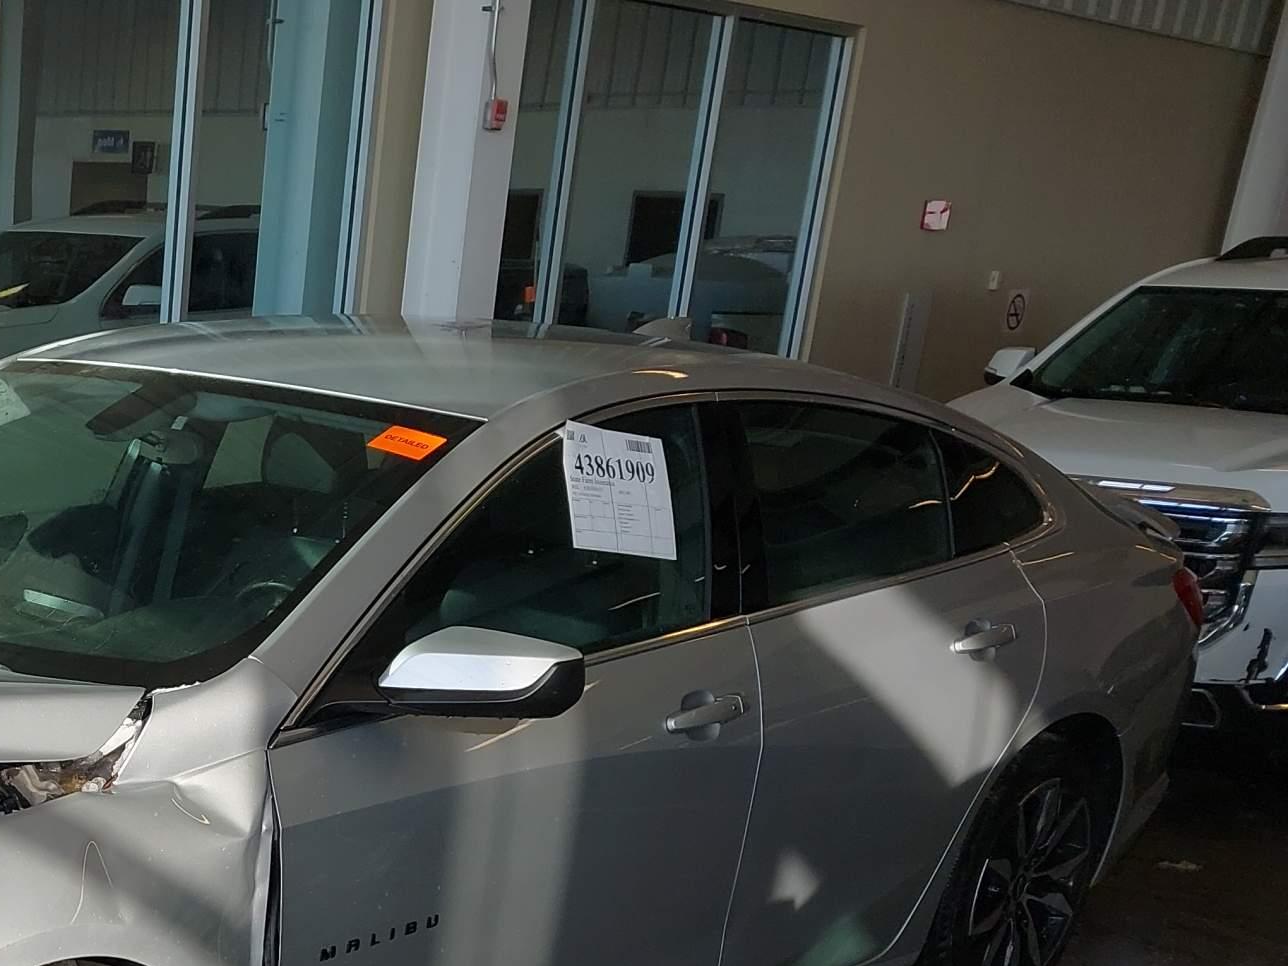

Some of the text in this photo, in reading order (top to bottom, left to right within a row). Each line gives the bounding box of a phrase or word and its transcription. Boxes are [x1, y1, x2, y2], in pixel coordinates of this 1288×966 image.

[384, 434, 429, 450] DETAILED
[574, 453, 655, 483] 43861909
[320, 914, 439, 961] MALIBU
